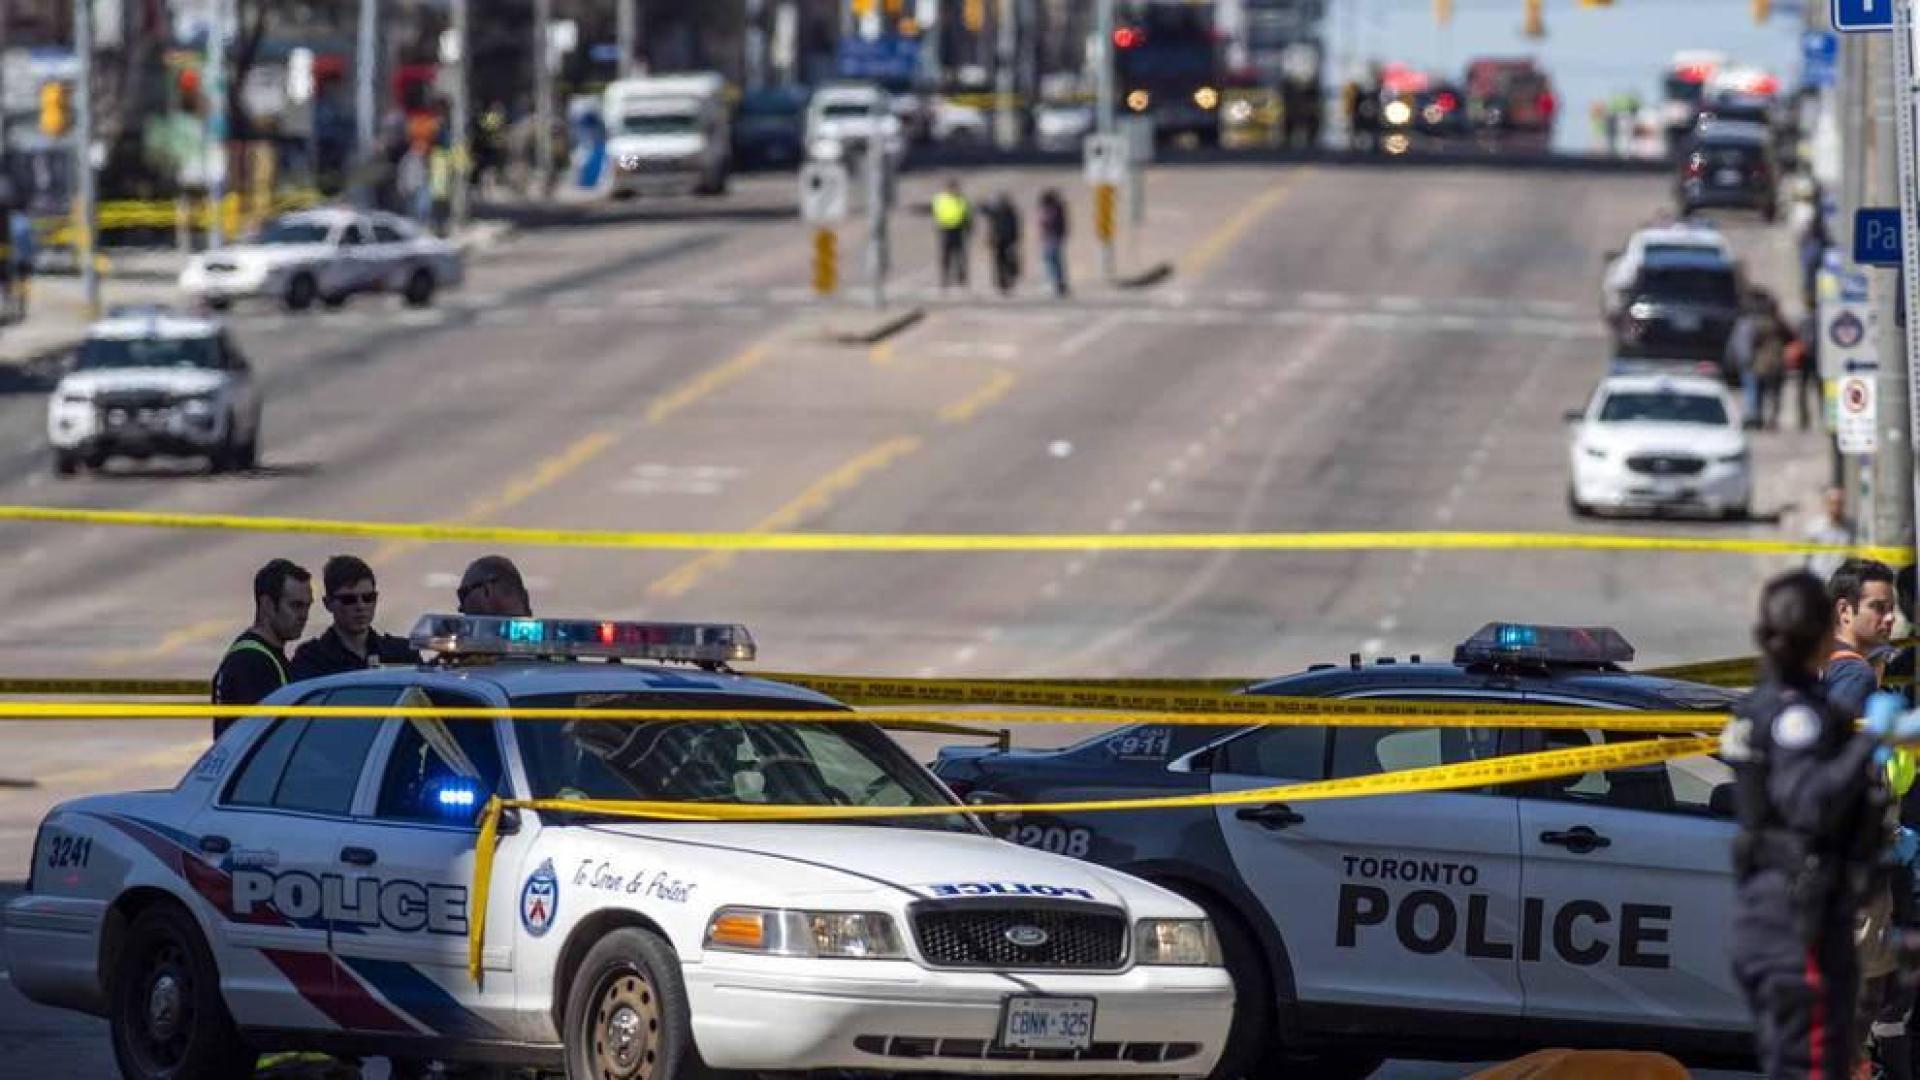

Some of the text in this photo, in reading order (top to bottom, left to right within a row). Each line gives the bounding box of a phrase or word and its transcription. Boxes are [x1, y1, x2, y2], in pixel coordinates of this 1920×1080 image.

[48, 836, 94, 869] 3241
[1343, 855, 1479, 886] TORONTO
[231, 868, 469, 937] POLICE
[1336, 883, 1673, 970] POLICE
